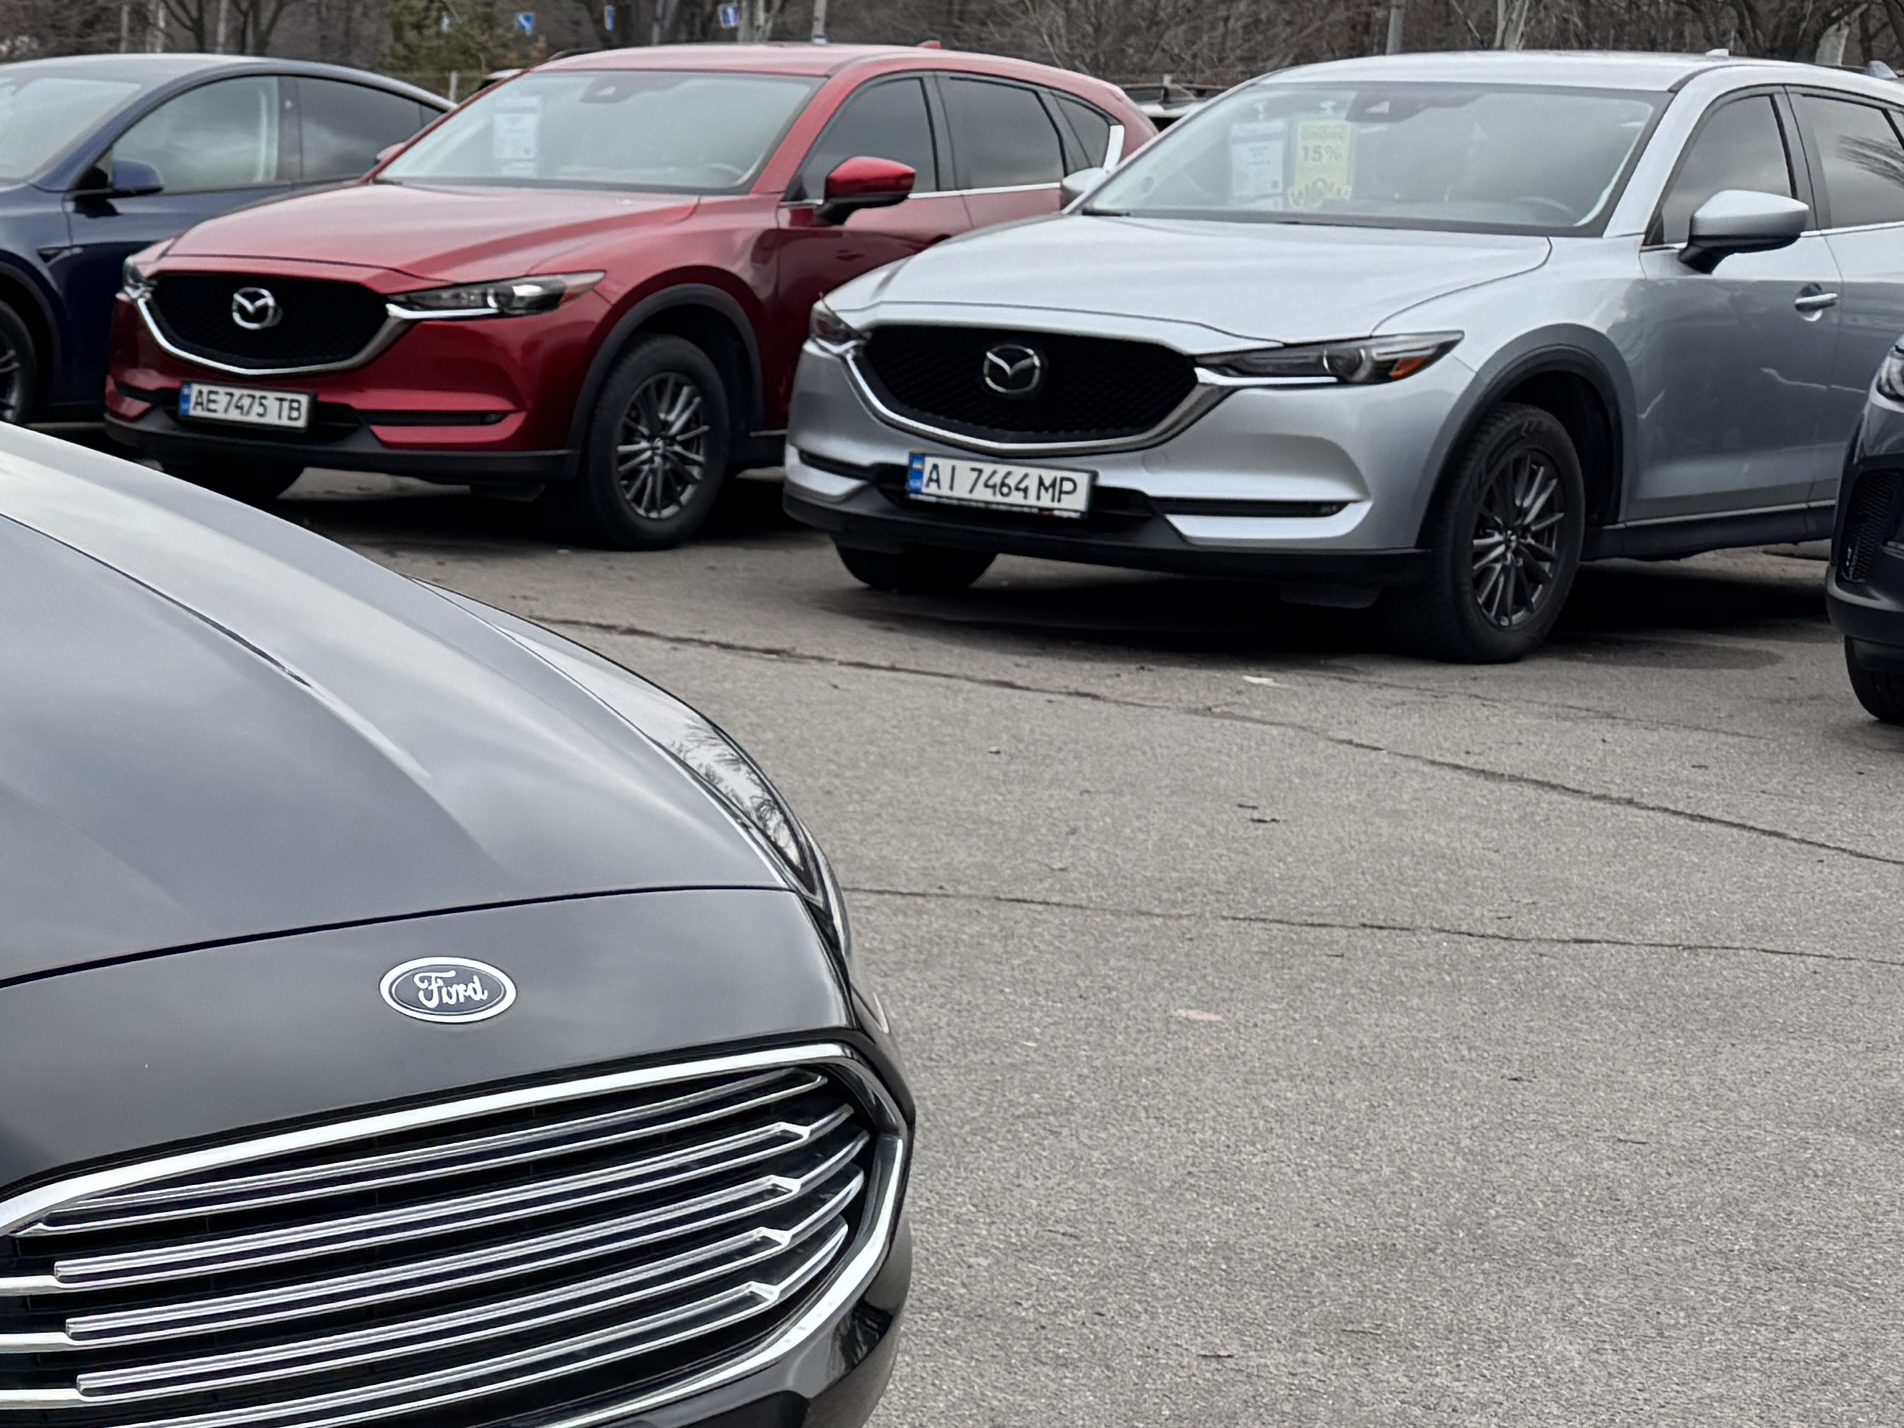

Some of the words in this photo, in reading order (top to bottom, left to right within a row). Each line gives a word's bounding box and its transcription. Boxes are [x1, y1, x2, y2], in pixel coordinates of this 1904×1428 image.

[193, 388, 220, 414] AE
[223, 391, 268, 418] 7475
[274, 396, 302, 422] TB
[925, 463, 956, 492] AI
[968, 467, 1030, 500] 7464
[1036, 474, 1078, 504] MP
[413, 970, 488, 1008] Ford
